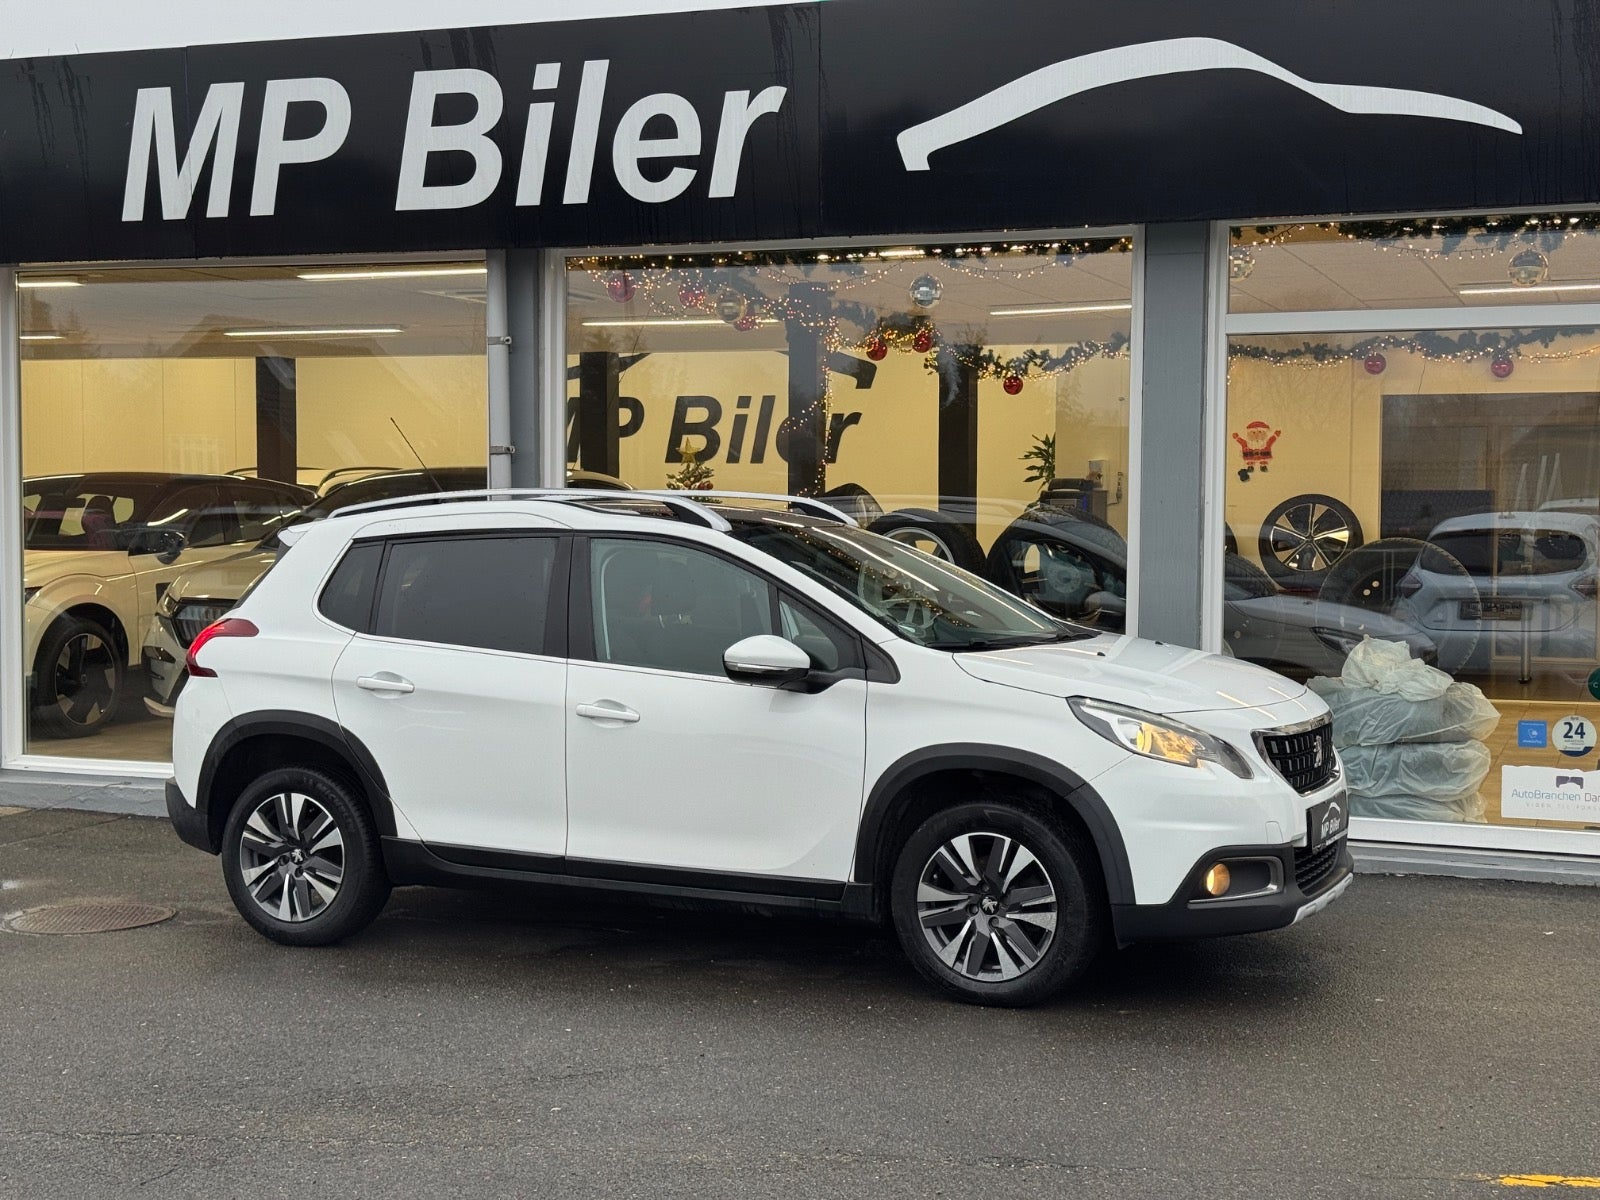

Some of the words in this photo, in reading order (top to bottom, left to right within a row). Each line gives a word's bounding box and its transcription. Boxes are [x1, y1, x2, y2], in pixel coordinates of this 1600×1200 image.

[121, 77, 351, 222] MP
[395, 59, 787, 211] Biler
[1563, 721, 1586, 739] 24
[1511, 789, 1581, 801] AutoBranchen
[1321, 821, 1330, 840] MP
